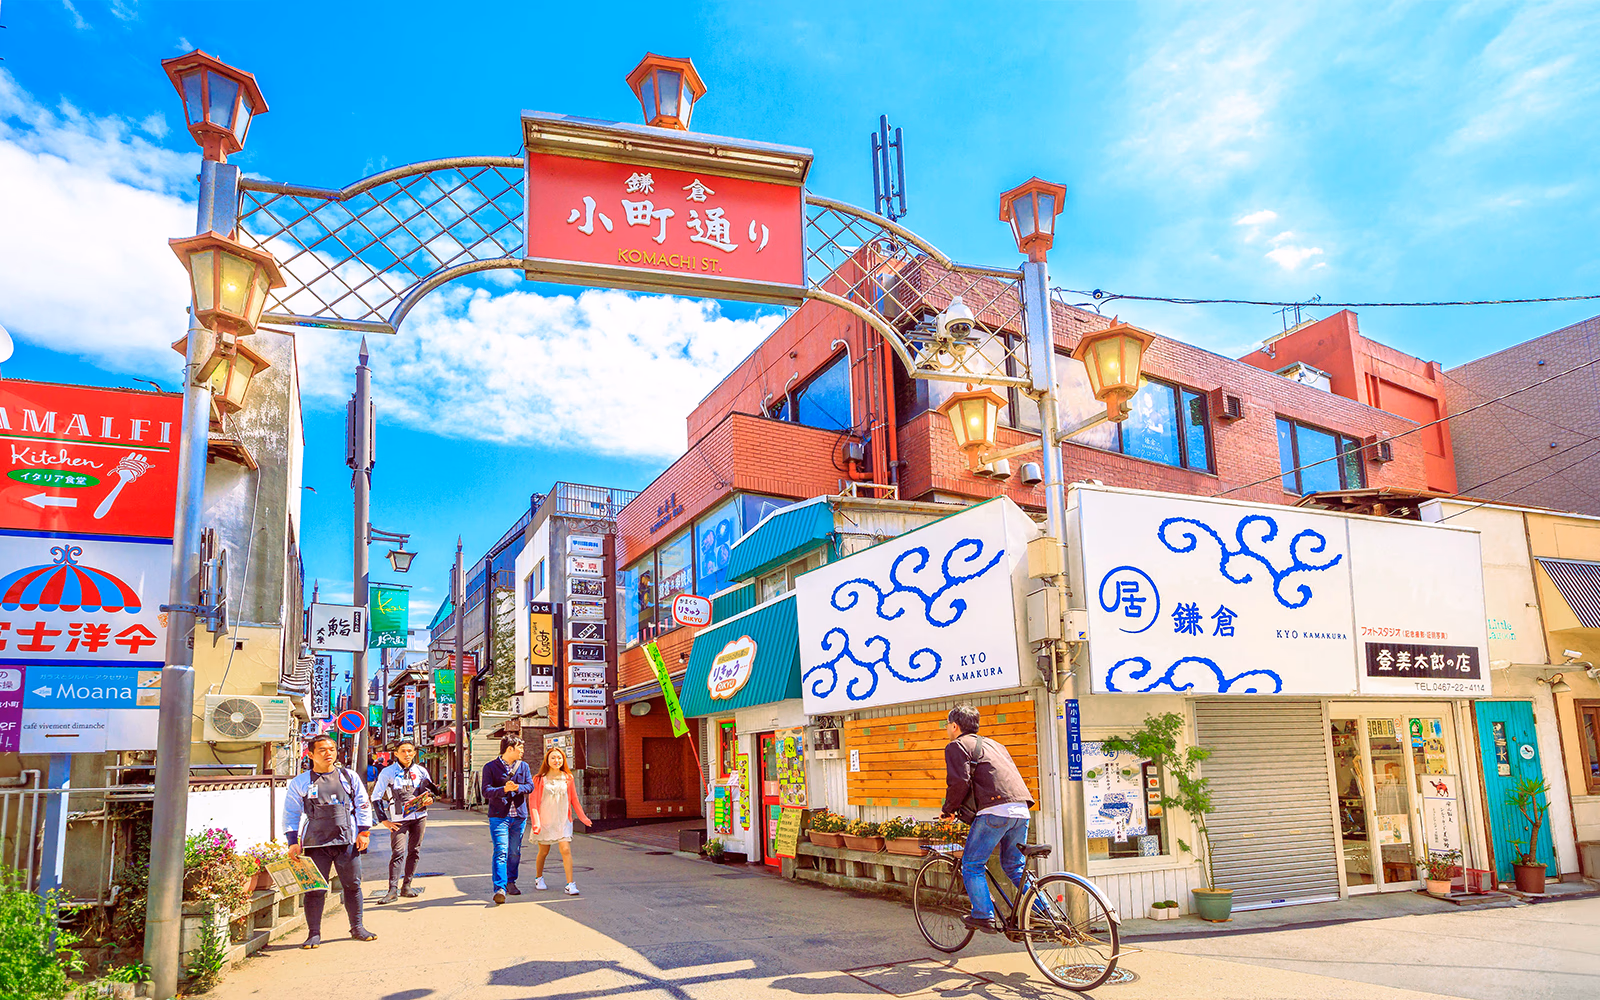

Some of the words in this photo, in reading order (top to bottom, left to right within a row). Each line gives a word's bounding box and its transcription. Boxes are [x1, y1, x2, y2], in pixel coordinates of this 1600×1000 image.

[624, 172, 715, 203] 鎌倉
[567, 196, 770, 253] 小町通り
[618, 248, 697, 270] KOMACHI
[701, 257, 723, 272] ST.
[11, 444, 103, 468] Kitchen
[21, 471, 87, 486] イタリア食堂
[678, 607, 700, 615] りきゅう
[1171, 602, 1238, 636] 鎌倉
[328, 616, 351, 637] 鮨
[1361, 626, 1401, 637] フォトスタジオ
[1276, 630, 1299, 639] KYO
[1303, 632, 1347, 640] KAMAKURA
[960, 652, 987, 666] KYO
[1376, 649, 1471, 672] 登美太郎の店
[713, 660, 740, 682] りきゅう
[949, 667, 1003, 682] KAMAKURA
[56, 683, 132, 699] Moana
[23, 722, 38, 730] café
[72, 722, 105, 730] dimanche
[586, 717, 604, 726] てまり
[1070, 709, 1078, 750] 小町二丁目
[1070, 754, 1082, 762] 10
